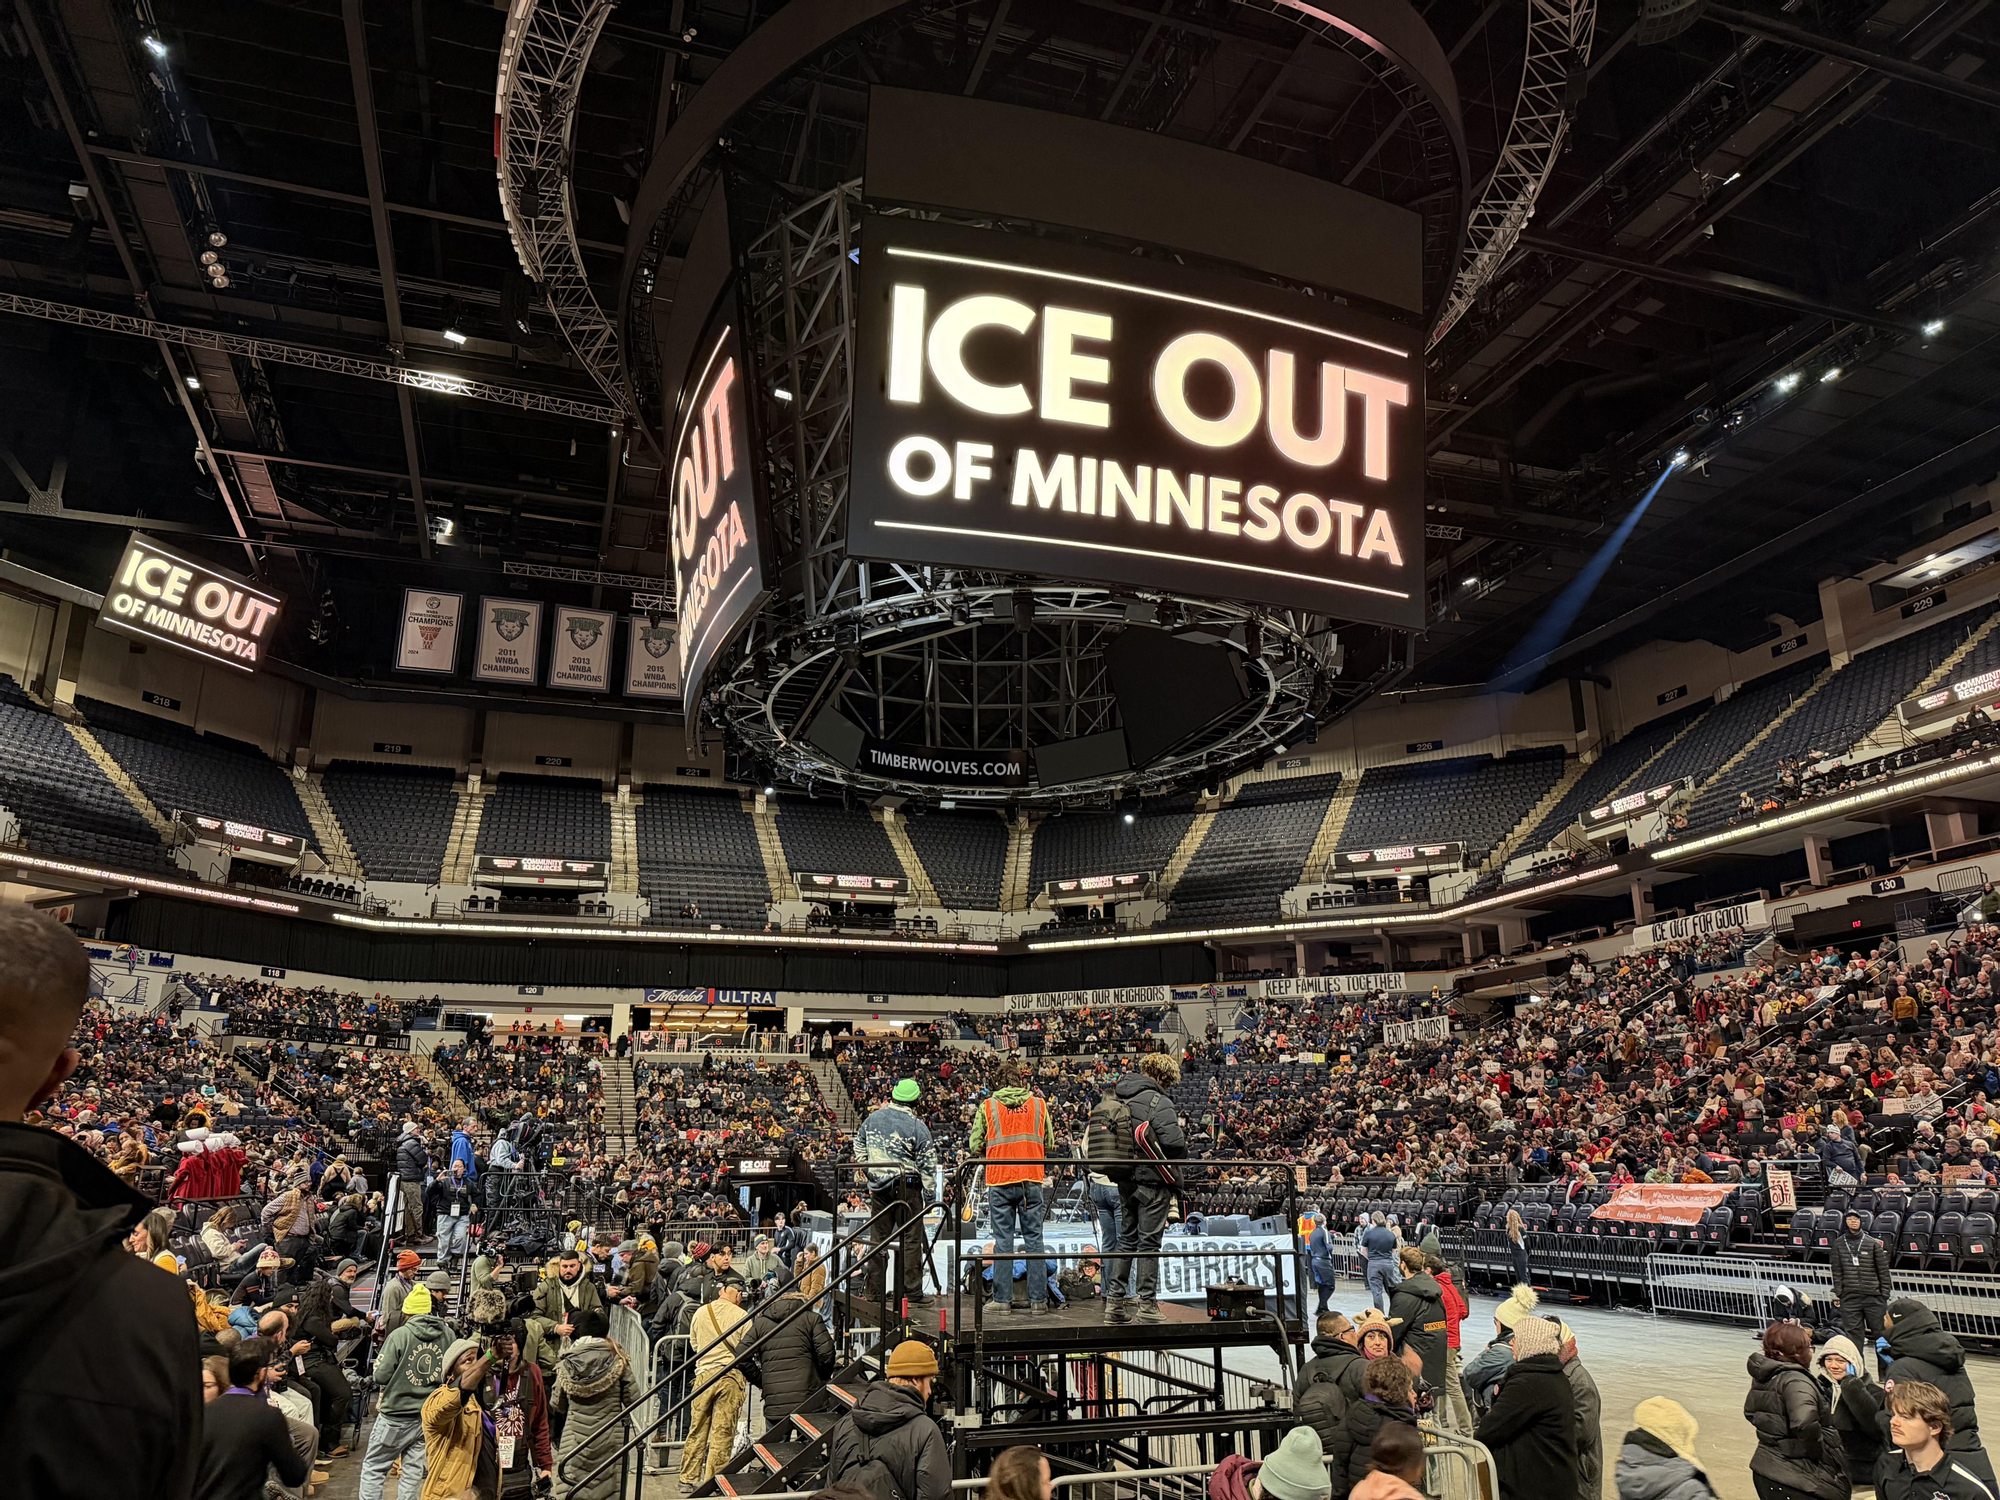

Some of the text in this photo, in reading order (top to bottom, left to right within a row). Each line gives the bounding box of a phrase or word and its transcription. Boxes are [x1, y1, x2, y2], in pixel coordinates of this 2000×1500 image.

[888, 284, 1408, 481] ICE OUT
[679, 357, 735, 559] OUT
[888, 436, 1404, 566] OF MINNESOTA
[121, 550, 278, 637] ICE OUT
[1913, 596, 1934, 612] 229
[114, 594, 258, 662] OF MINNESOTA
[408, 616, 454, 627] CHAMPIONS
[498, 648, 516, 656] 2011
[1780, 639, 1798, 653] 228
[495, 656, 518, 666] WNBA
[572, 656, 590, 665] 2013
[482, 664, 530, 675] CHAMPIONS
[569, 664, 592, 673] WNBA
[556, 671, 602, 683] CHAMPIONS
[644, 673, 666, 681] WNBA
[632, 680, 676, 690] CHAMPIONS
[152, 695, 170, 707] 218
[1664, 689, 1678, 702] 227
[384, 744, 402, 752] 219
[1416, 743, 1432, 751] 226
[545, 758, 562, 766] 220
[870, 750, 1021, 776] TIMBERWOLVES.COM
[1286, 760, 1301, 768] 225
[1894, 780, 1914, 792] NEVER
[1914, 776, 1924, 786] DID
[1926, 772, 1940, 783] AND
[1940, 770, 1946, 779] IT
[1946, 764, 1968, 777] NEVER
[225, 821, 264, 834] COMMUNITY
[226, 828, 263, 842] RESOURCES
[522, 858, 564, 866] COMMUNITY
[1878, 880, 1896, 890] 130
[1652, 904, 1748, 942] ICE OUT FOR GOOD!
[1171, 984, 1246, 999] Treasure Island
[1266, 974, 1402, 996] KEEP FAMILIES TOGETHER
[647, 989, 774, 1004] Michelob ULTRA
[1011, 986, 1164, 1009] STOP KIDNAPPING OUR NEIGHBORS
[1387, 1026, 1400, 1045] END
[1404, 1022, 1416, 1042] ICE
[1770, 1180, 1790, 1192] ICE
[1772, 1192, 1791, 1204] OUT!
[1616, 1210, 1634, 1218] Hilton
[408, 1342, 444, 1361] CARHARTT
[406, 1369, 423, 1386] SINCE
